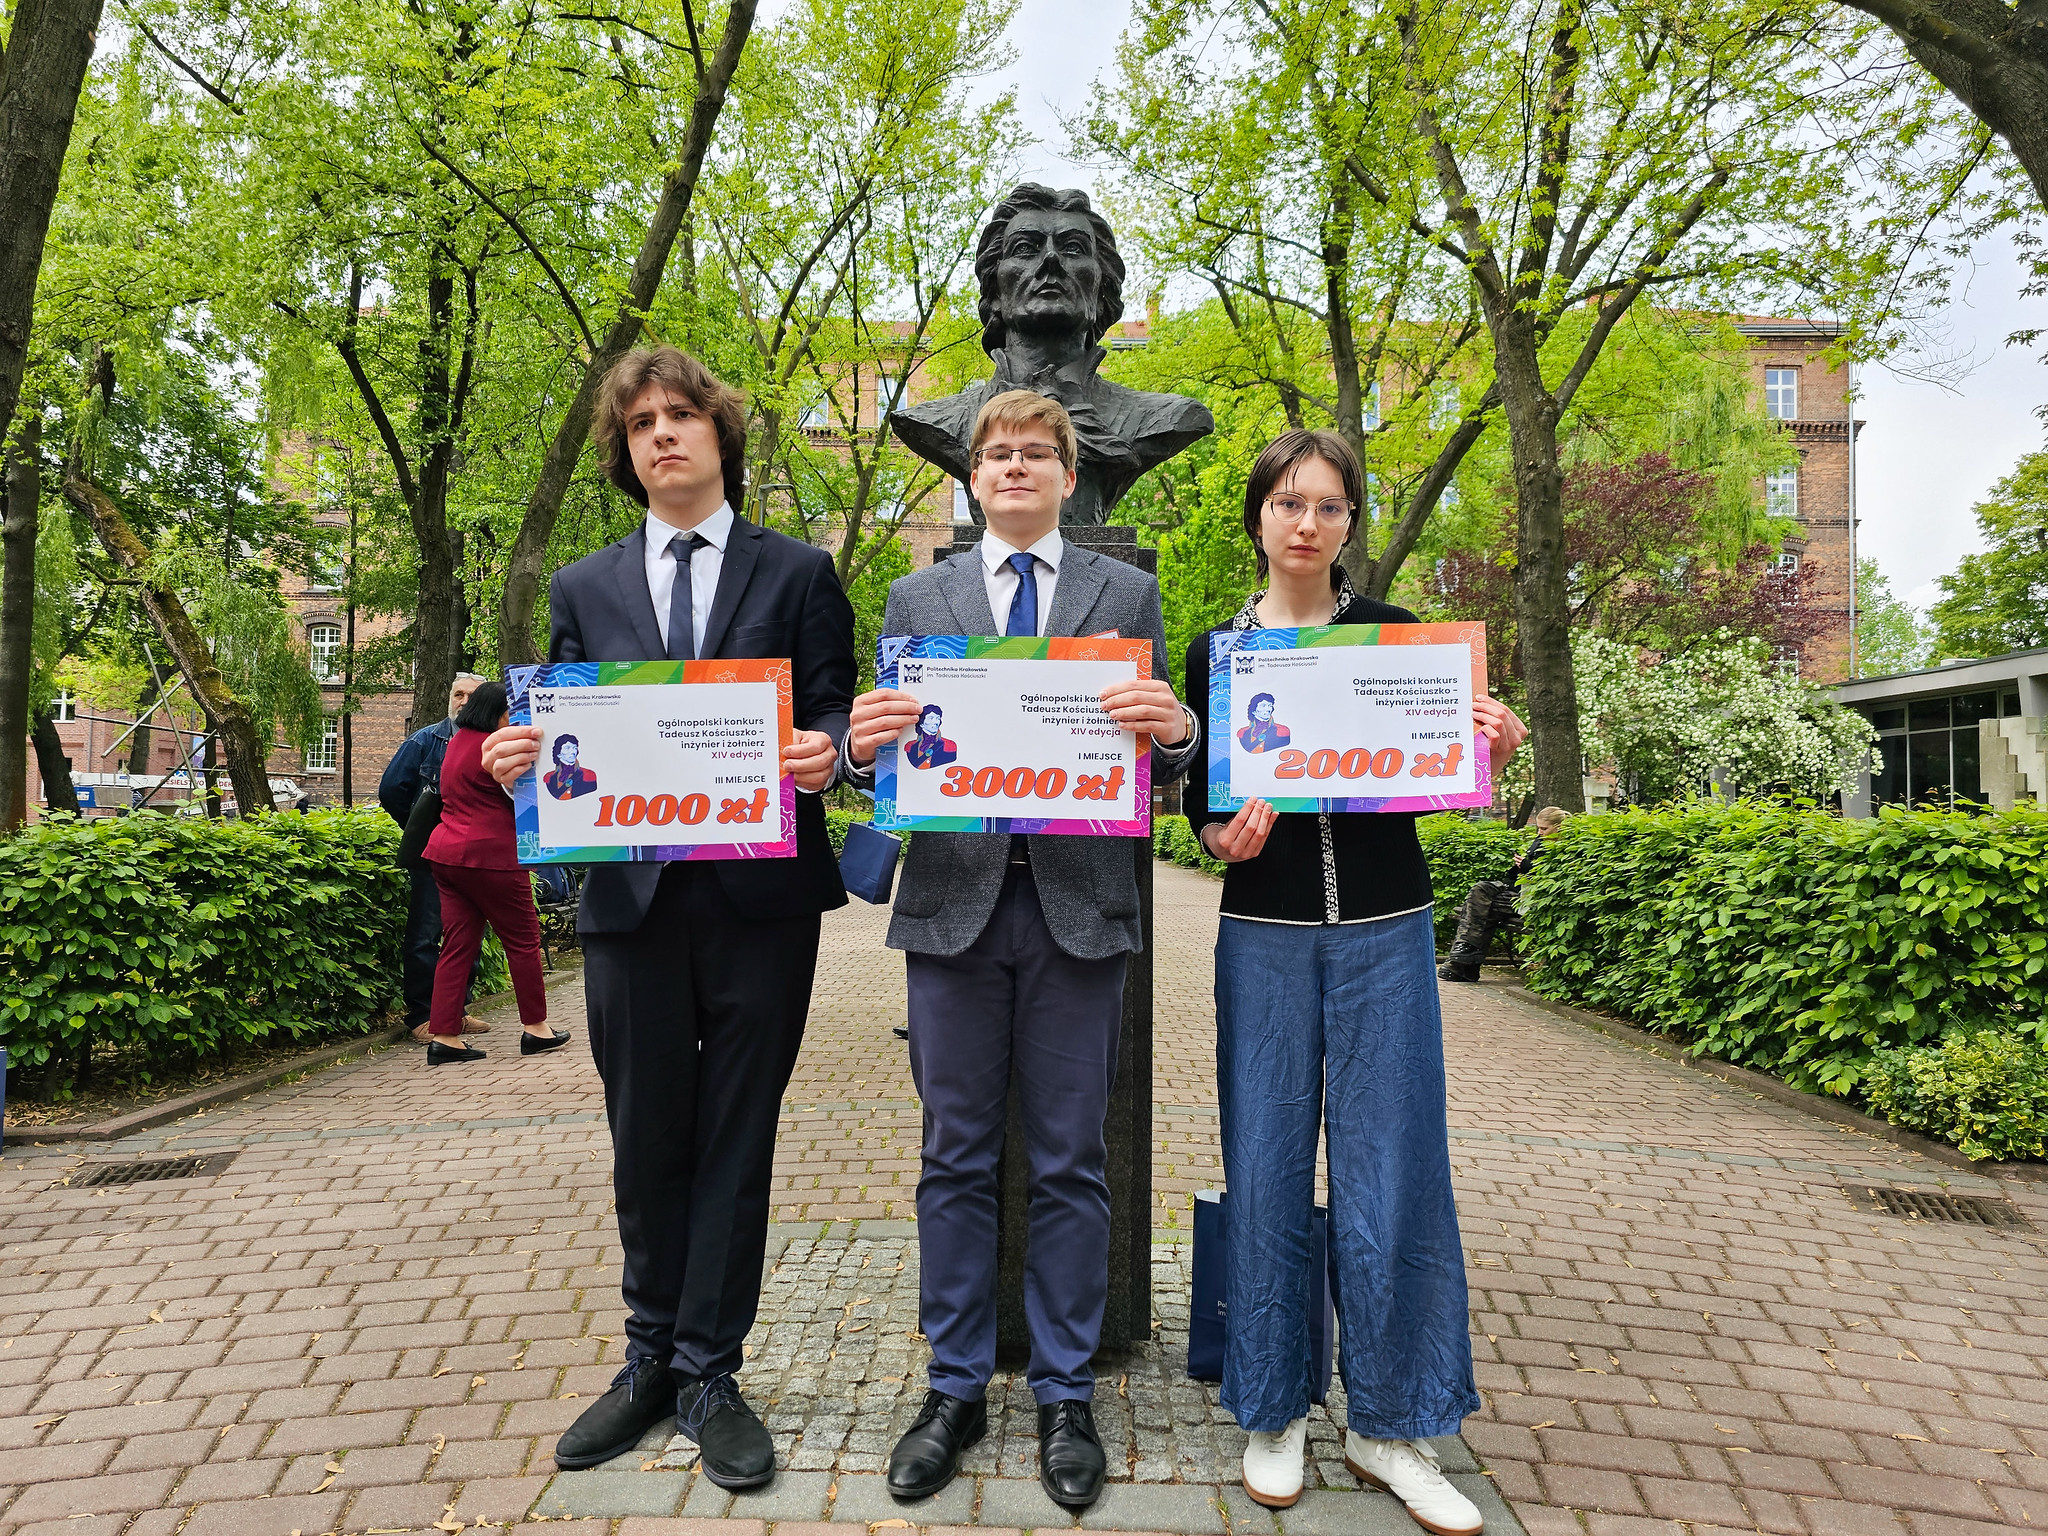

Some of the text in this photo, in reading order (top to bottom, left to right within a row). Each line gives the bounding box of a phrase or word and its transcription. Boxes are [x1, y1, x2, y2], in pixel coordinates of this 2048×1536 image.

[1352, 677, 1458, 687] Ogólnopolski konkurs
[1354, 688, 1394, 696] Tadeusz
[1396, 687, 1451, 696] Kościuszko
[1020, 694, 1082, 704] Ogólnopolski
[1375, 698, 1414, 708] inżynier
[1421, 697, 1459, 706] żołnierz
[1022, 705, 1060, 713] Tadeusz
[1424, 708, 1457, 718] edycja
[657, 717, 764, 729] Ogólnopolski konkurs
[1042, 716, 1080, 726] inżynier
[1086, 716, 1120, 725] żołnier
[659, 730, 700, 739] Tadeusz
[702, 729, 757, 738] Kościuszko
[1088, 728, 1120, 737] edycja
[1411, 731, 1460, 740] II MIEJSCE
[681, 740, 719, 750] inżynier
[727, 739, 765, 748] żołnierz
[711, 750, 763, 760] XIV edycja
[1274, 743, 1464, 779] 2000 zł
[715, 775, 766, 784] III MIEJSCE
[940, 766, 1126, 800] 3000 zł
[594, 788, 770, 827] 1000 zł
